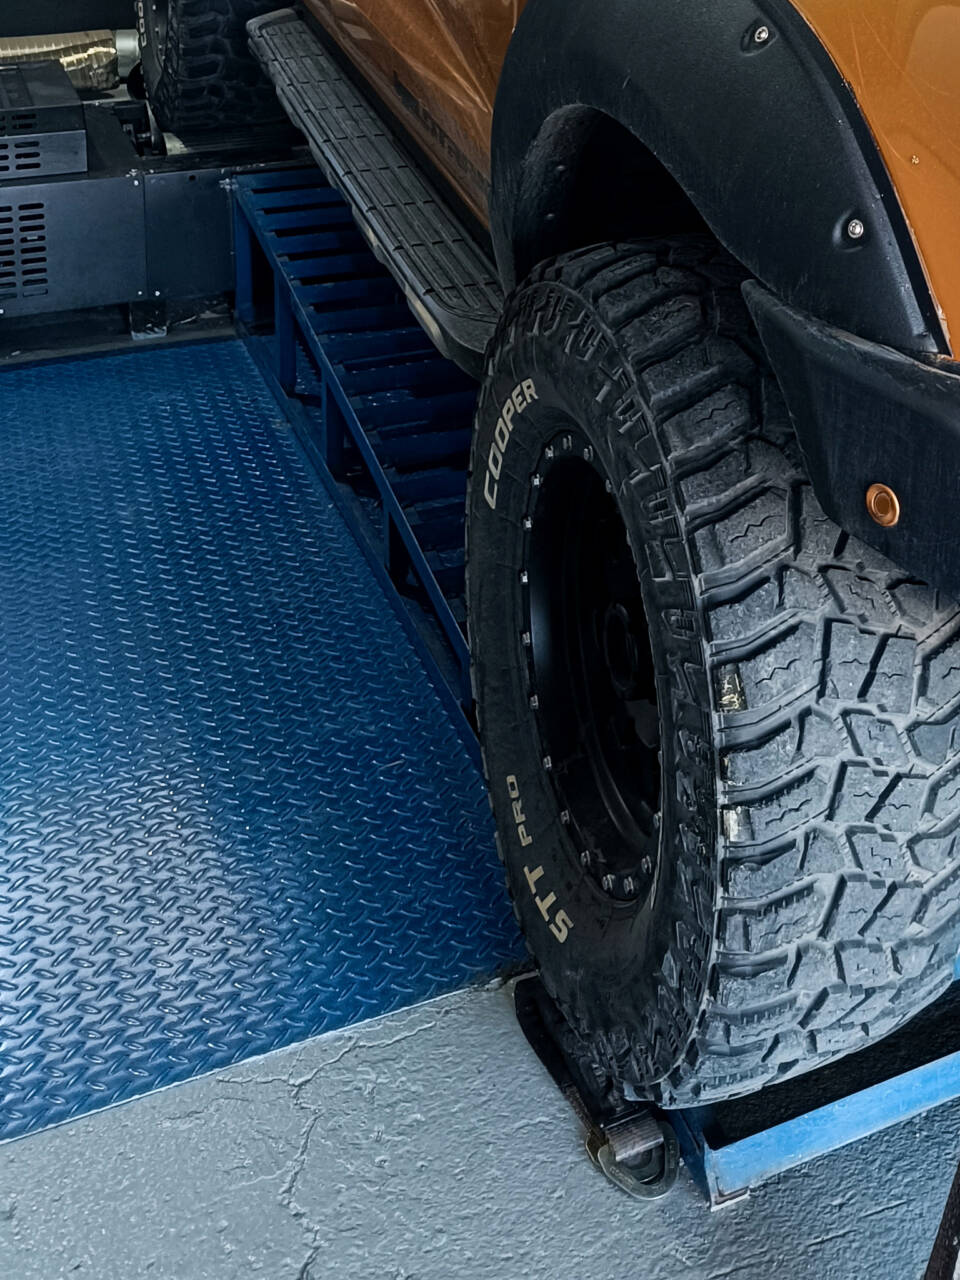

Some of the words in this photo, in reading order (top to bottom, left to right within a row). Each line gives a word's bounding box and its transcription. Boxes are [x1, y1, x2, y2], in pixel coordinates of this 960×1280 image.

[483, 378, 539, 510] COOPER
[506, 774, 533, 847] PRO
[523, 865, 574, 944] STT
